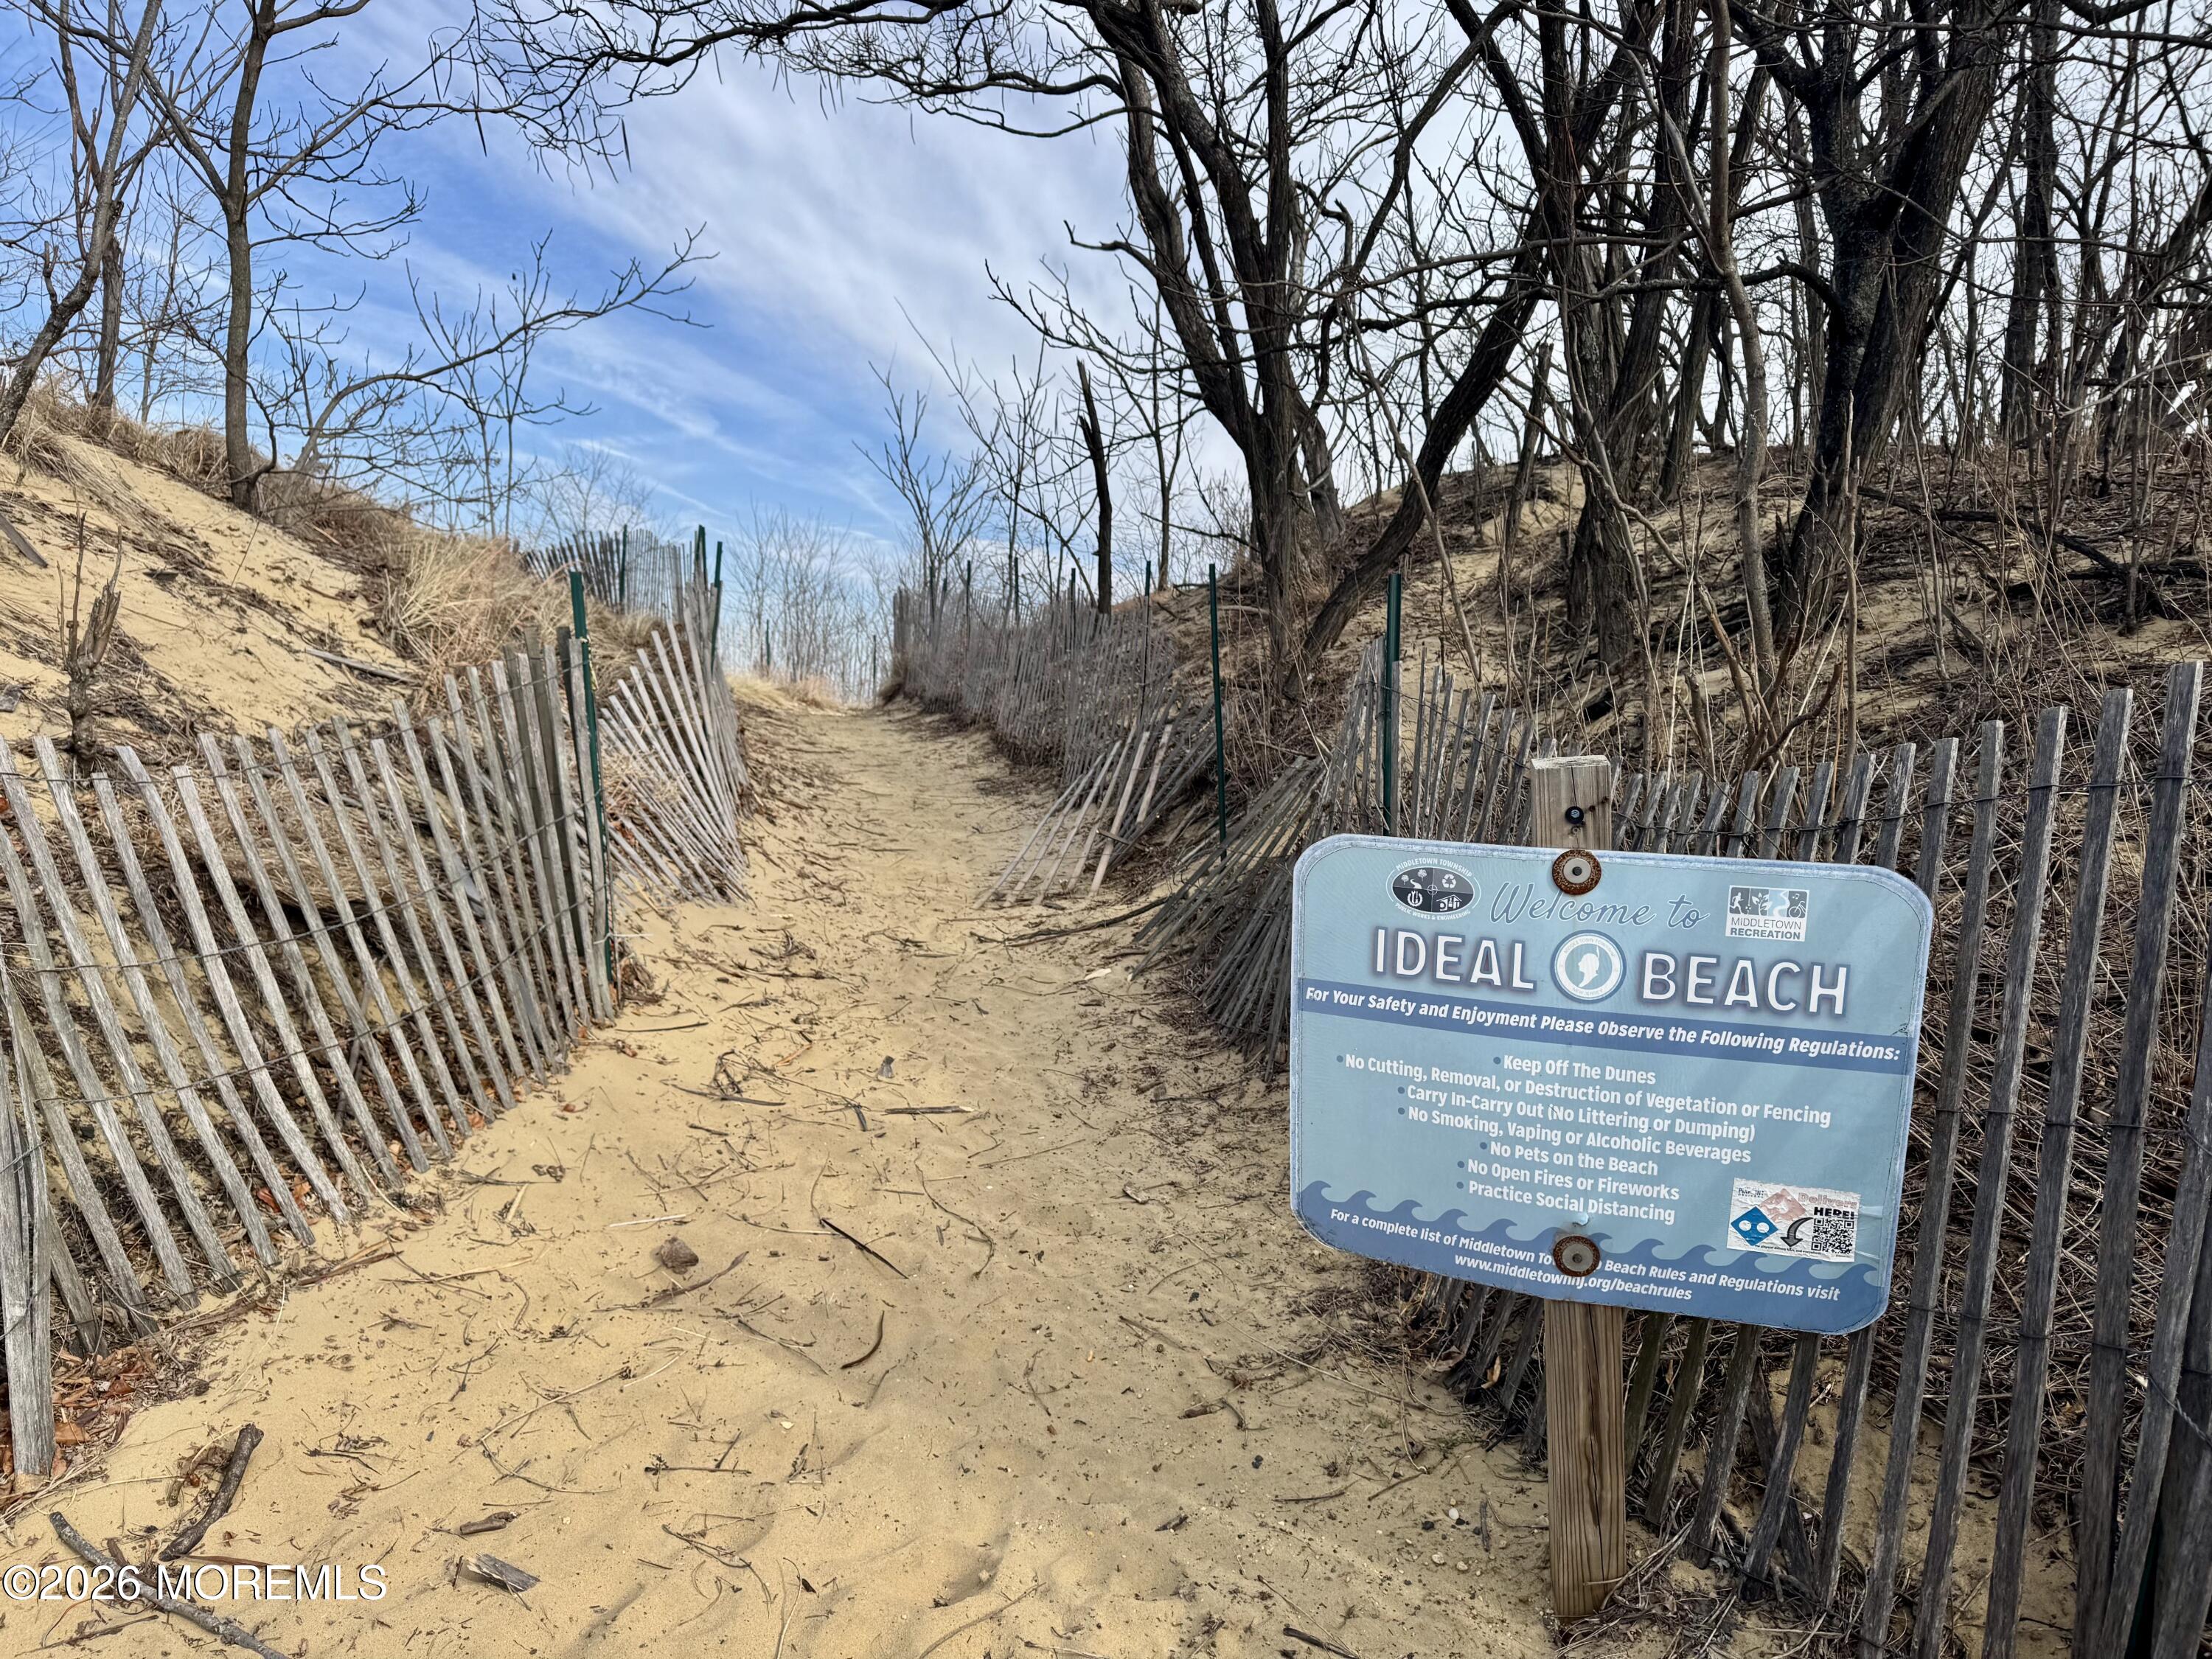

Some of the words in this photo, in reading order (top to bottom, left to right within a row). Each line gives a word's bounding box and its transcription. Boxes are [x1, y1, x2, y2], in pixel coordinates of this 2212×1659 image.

[1395, 858, 1438, 871] MIDDLETOWN
[1439, 858, 1472, 877] TOWNSHIP
[1395, 903, 1411, 914] PUBLIC
[1413, 911, 1431, 919] WORKS
[1490, 881, 1657, 925] Welcome
[1667, 894, 1711, 929] to
[1731, 917, 1801, 930] MIDDLETOWN
[1730, 928, 1801, 940] RECREATION
[1375, 927, 1536, 991] IDEAL
[1641, 951, 1849, 1016] BEACH
[1306, 987, 1329, 1001] For
[1333, 990, 1366, 1006] Your
[1368, 996, 1416, 1017] Safety
[1419, 1004, 1447, 1018] and
[1452, 1006, 1537, 1029] Enjoyment
[1540, 1015, 1594, 1034] Please
[1598, 1020, 1664, 1040] Observe
[1669, 1026, 1697, 1043] the
[1700, 1029, 1785, 1054] Following
[1789, 1037, 1901, 1060] Regulations:
[1346, 1054, 1365, 1069] No
[1368, 1057, 1427, 1082] Cutting,
[1431, 1067, 1500, 1093] Removal,
[1504, 1080, 1522, 1093] or
[1525, 1080, 1621, 1105] Destruction
[1624, 1090, 1643, 1106] of
[1646, 1092, 1737, 1116] Vegetation
[1742, 1103, 1760, 1118] or
[1764, 1102, 1832, 1129] Fencing
[1503, 1055, 1542, 1077] Keep
[1545, 1060, 1570, 1075] Off
[1573, 1062, 1601, 1079] The
[1605, 1065, 1656, 1085] Dunes
[1407, 1085, 1447, 1107] Carry
[1451, 1091, 1513, 1117] In-Carry
[1517, 1101, 1544, 1119] Out
[1548, 1103, 1575, 1122] (No
[1578, 1108, 1649, 1133] Littering
[1653, 1119, 1672, 1132] or
[1674, 1119, 1756, 1144] Dumping)
[1408, 1106, 1428, 1122] No
[1431, 1108, 1504, 1138] Smoking,
[1507, 1121, 1562, 1145] Vaping
[1565, 1131, 1583, 1145] or
[1586, 1131, 1661, 1154] Alcoholic
[1665, 1140, 1752, 1164] Beverages
[1467, 1158, 1488, 1175] No
[1491, 1163, 1531, 1182] Open
[1534, 1169, 1573, 1189] Fires
[1576, 1177, 1594, 1191] or
[1598, 1178, 1680, 1201] Fireworks
[1490, 1141, 1511, 1158] No
[1514, 1145, 1549, 1164] Pets
[1553, 1151, 1573, 1166] on
[1578, 1152, 1604, 1170] the
[1608, 1157, 1659, 1176] Beach
[1469, 1180, 1532, 1204] Practice
[1536, 1192, 1585, 1213] Social
[1587, 1198, 1675, 1225] Distancing
[1798, 1192, 1858, 1209] Delivers
[1330, 1208, 1350, 1222] For
[1351, 1214, 1359, 1225] a
[1362, 1217, 1418, 1239] complete
[1420, 1227, 1441, 1243] list
[1443, 1231, 1459, 1246] of
[1459, 1237, 1535, 1262] Middletown
[1604, 1259, 1646, 1276] Beach
[1649, 1265, 1686, 1282] Rules
[1689, 1270, 1716, 1285] and
[1718, 1273, 1804, 1296] Regulations
[1807, 1284, 1841, 1301] visit
[1454, 1254, 1693, 1300] www.middletownnj.org/beachrules
